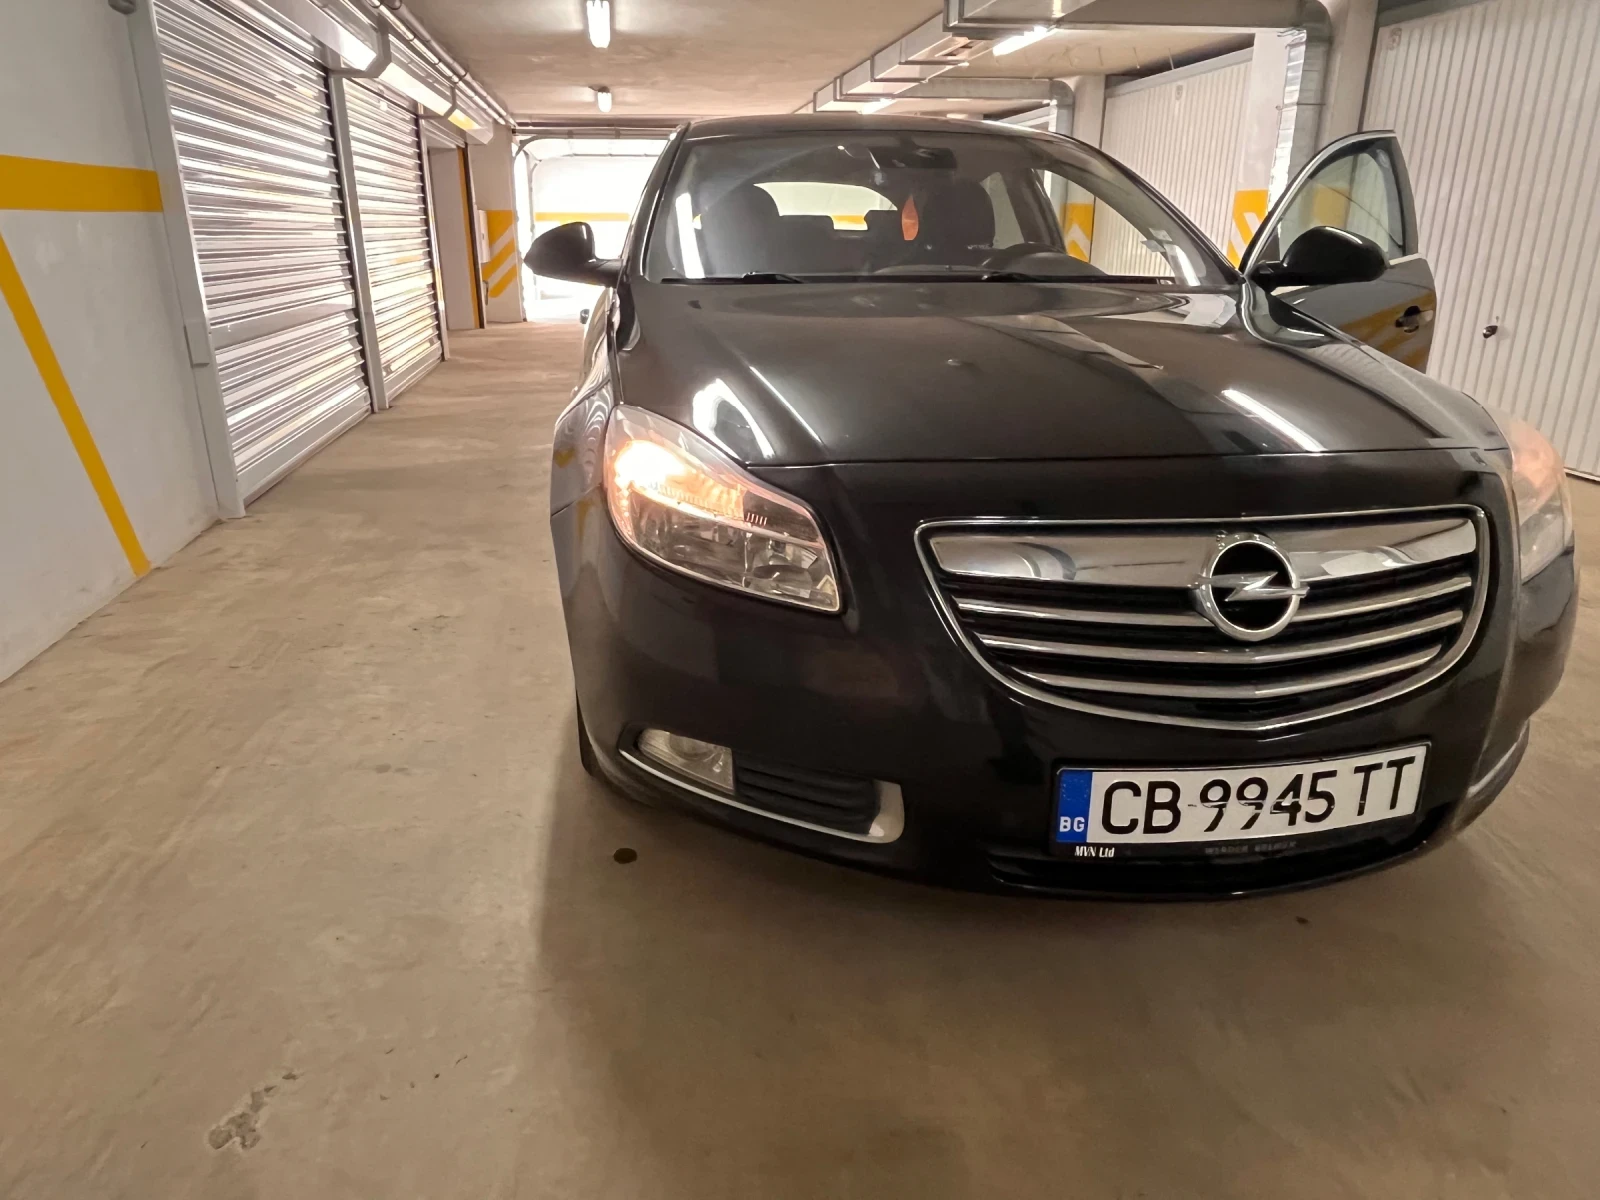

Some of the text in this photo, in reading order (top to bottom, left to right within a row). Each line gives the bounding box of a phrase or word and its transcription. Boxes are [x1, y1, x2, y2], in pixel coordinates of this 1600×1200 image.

[1102, 755, 1416, 835] CB 9945 TT
[1059, 816, 1085, 833] BG
[1074, 845, 1116, 858] MVN Ltd
